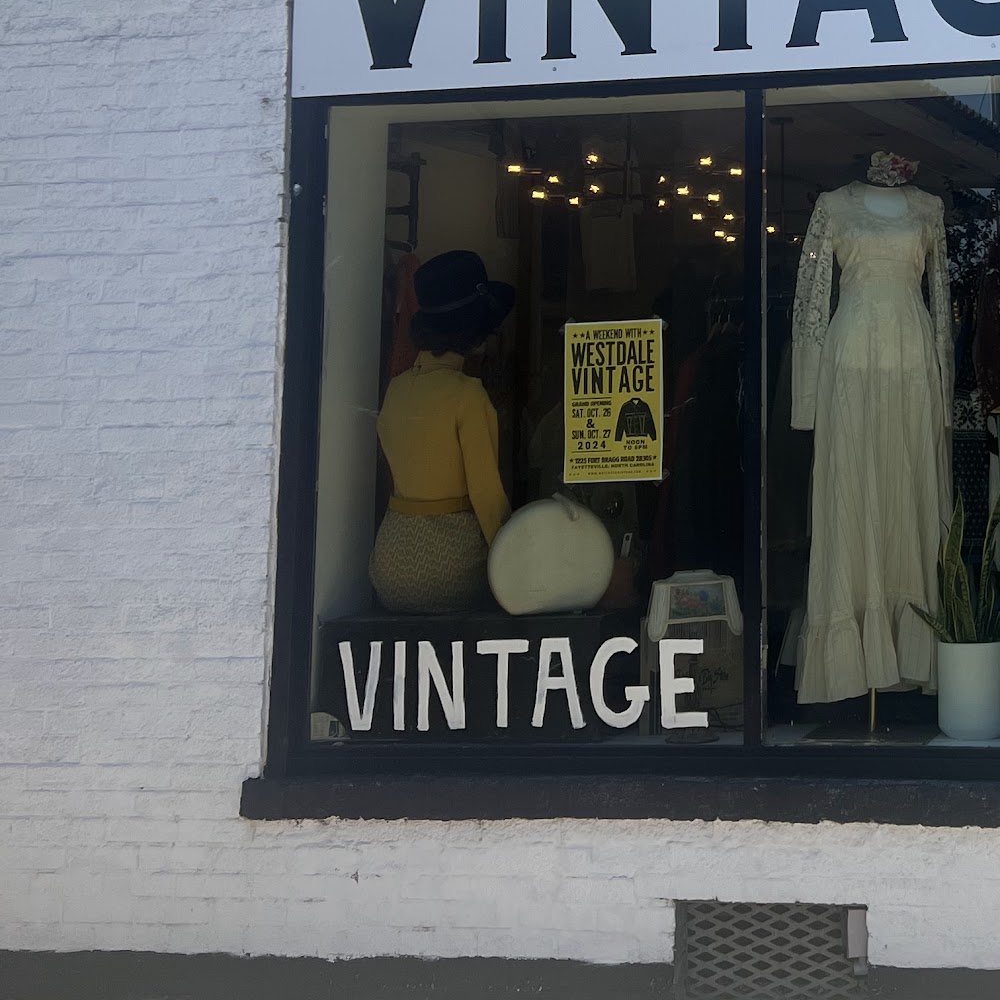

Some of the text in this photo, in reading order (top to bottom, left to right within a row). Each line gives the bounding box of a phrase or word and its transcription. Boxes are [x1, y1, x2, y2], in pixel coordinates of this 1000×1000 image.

[585, 328, 642, 340] A WEEKEND WITH
[571, 339, 655, 367] WESTDALE
[571, 365, 655, 395] VINTAGE
[602, 408, 612, 417] 26
[586, 418, 595, 428] &
[602, 429, 612, 439] 27
[577, 440, 607, 450] 2024
[338, 636, 709, 731] VINTAGE
